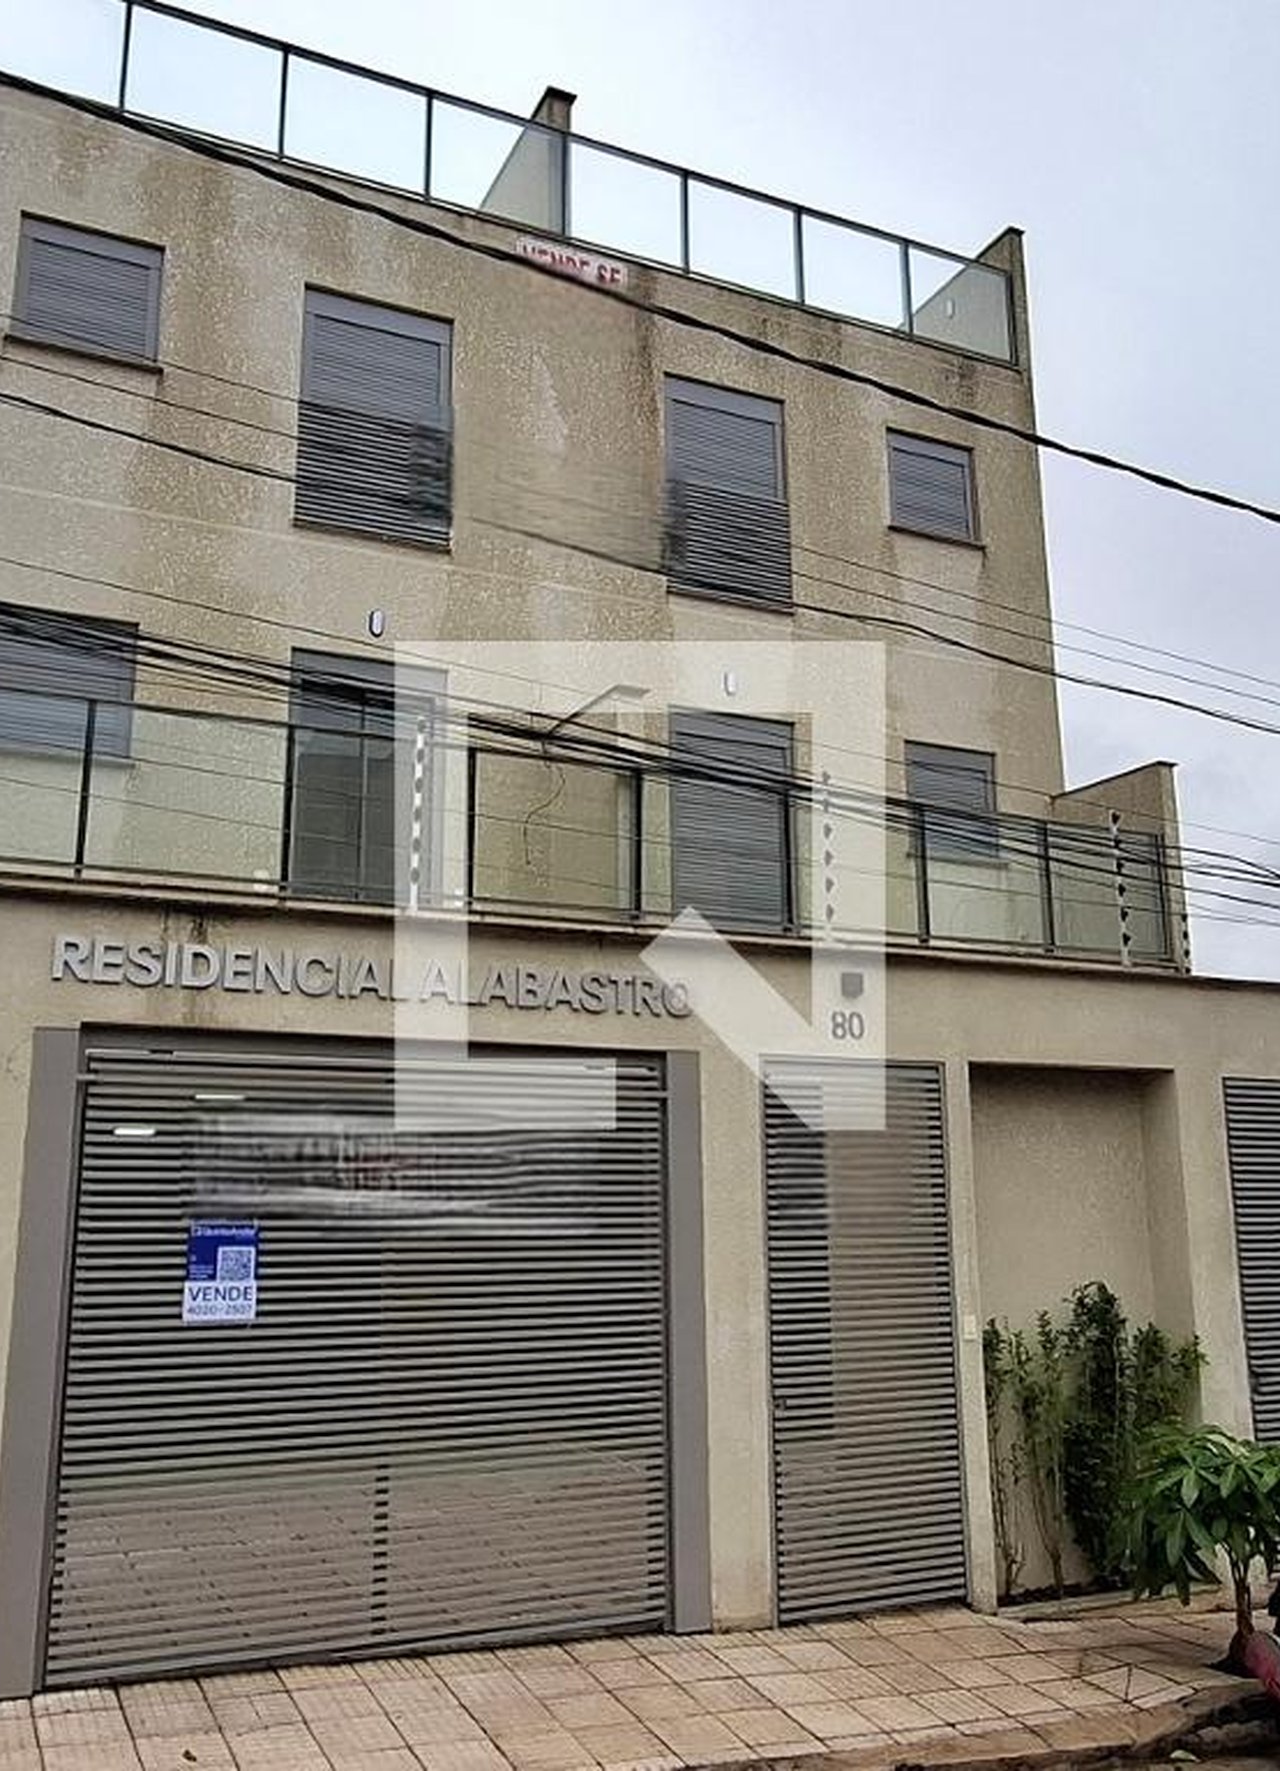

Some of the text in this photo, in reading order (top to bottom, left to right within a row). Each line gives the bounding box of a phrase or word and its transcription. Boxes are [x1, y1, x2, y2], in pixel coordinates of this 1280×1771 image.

[51, 935, 695, 1019] RESIDENCIAL ALABASTRO
[831, 1010, 866, 1041] 80
[188, 1286, 253, 1302] VENDE
